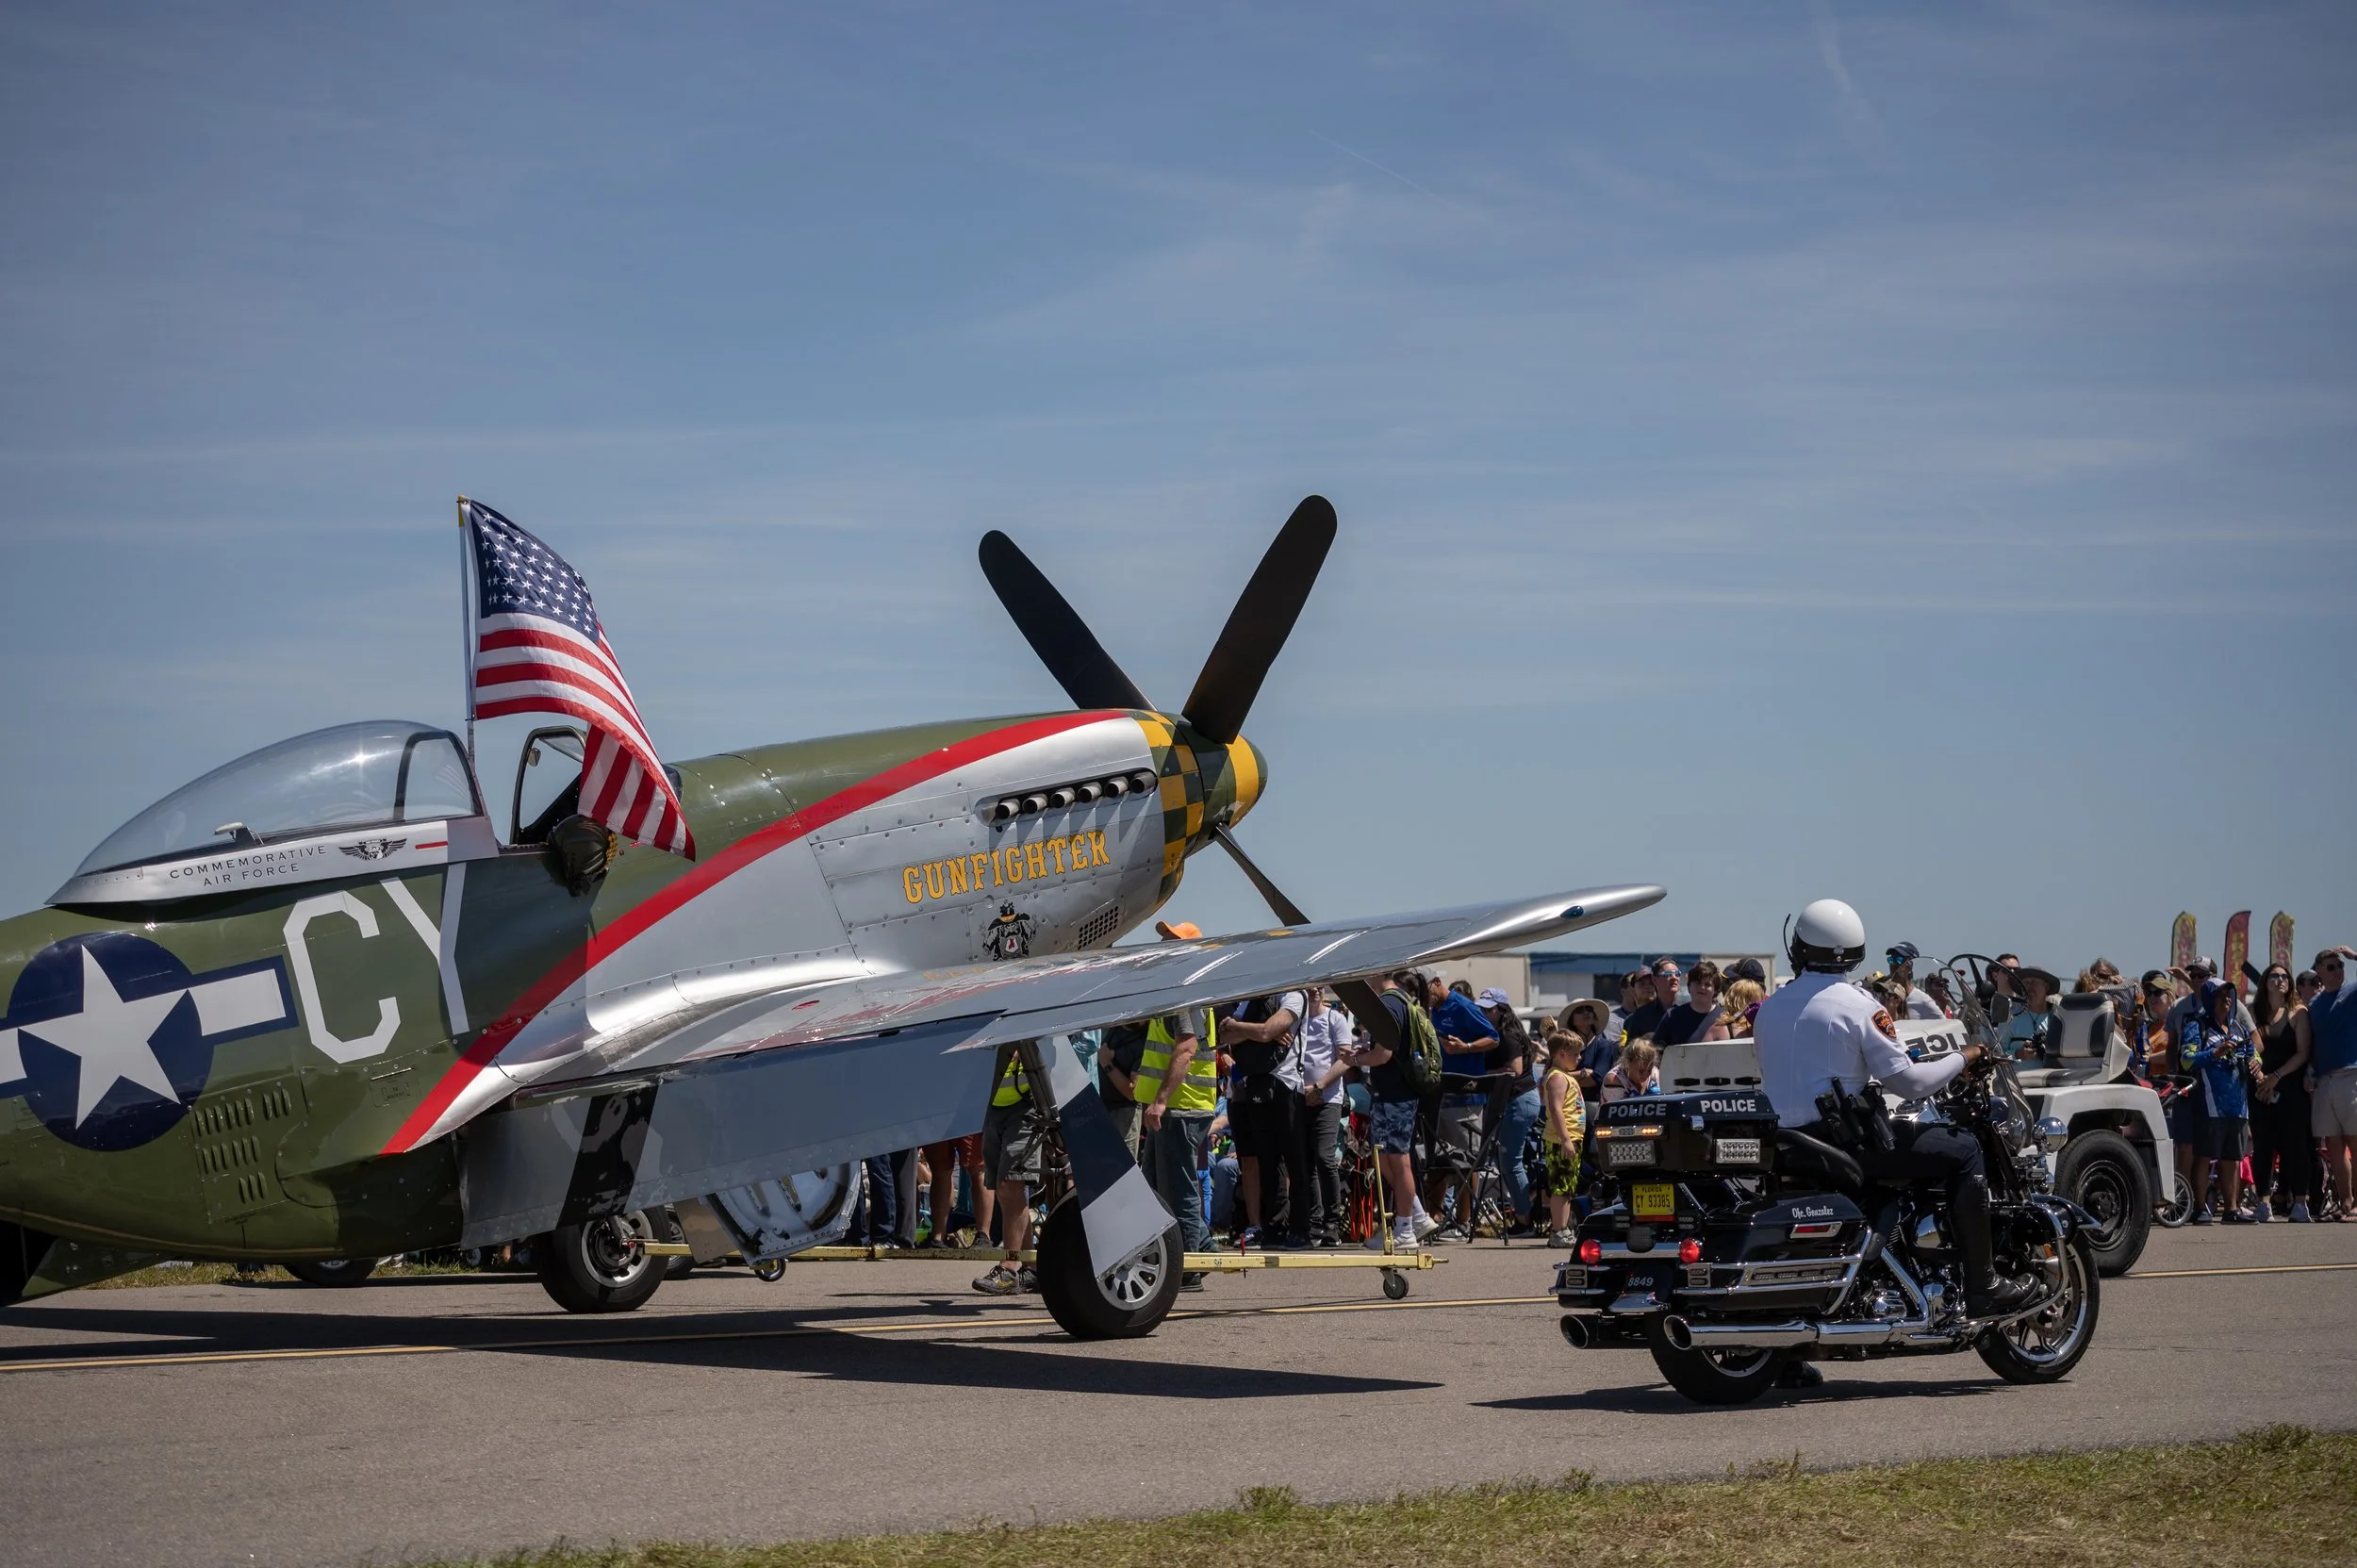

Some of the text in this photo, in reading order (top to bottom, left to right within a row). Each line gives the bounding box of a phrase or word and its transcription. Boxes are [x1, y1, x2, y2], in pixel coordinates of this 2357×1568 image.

[170, 845, 326, 879] COMMEMORATIVE
[902, 829, 1111, 904] GUNFIGHTER
[203, 863, 300, 887] AIR FORCE
[282, 861, 470, 1065] CY
[1607, 1103, 1667, 1119] POLICE
[1700, 1098, 1757, 1114] POLICE
[1635, 1194, 1671, 1208] CY 93385
[1627, 1276, 1655, 1287] 8849
